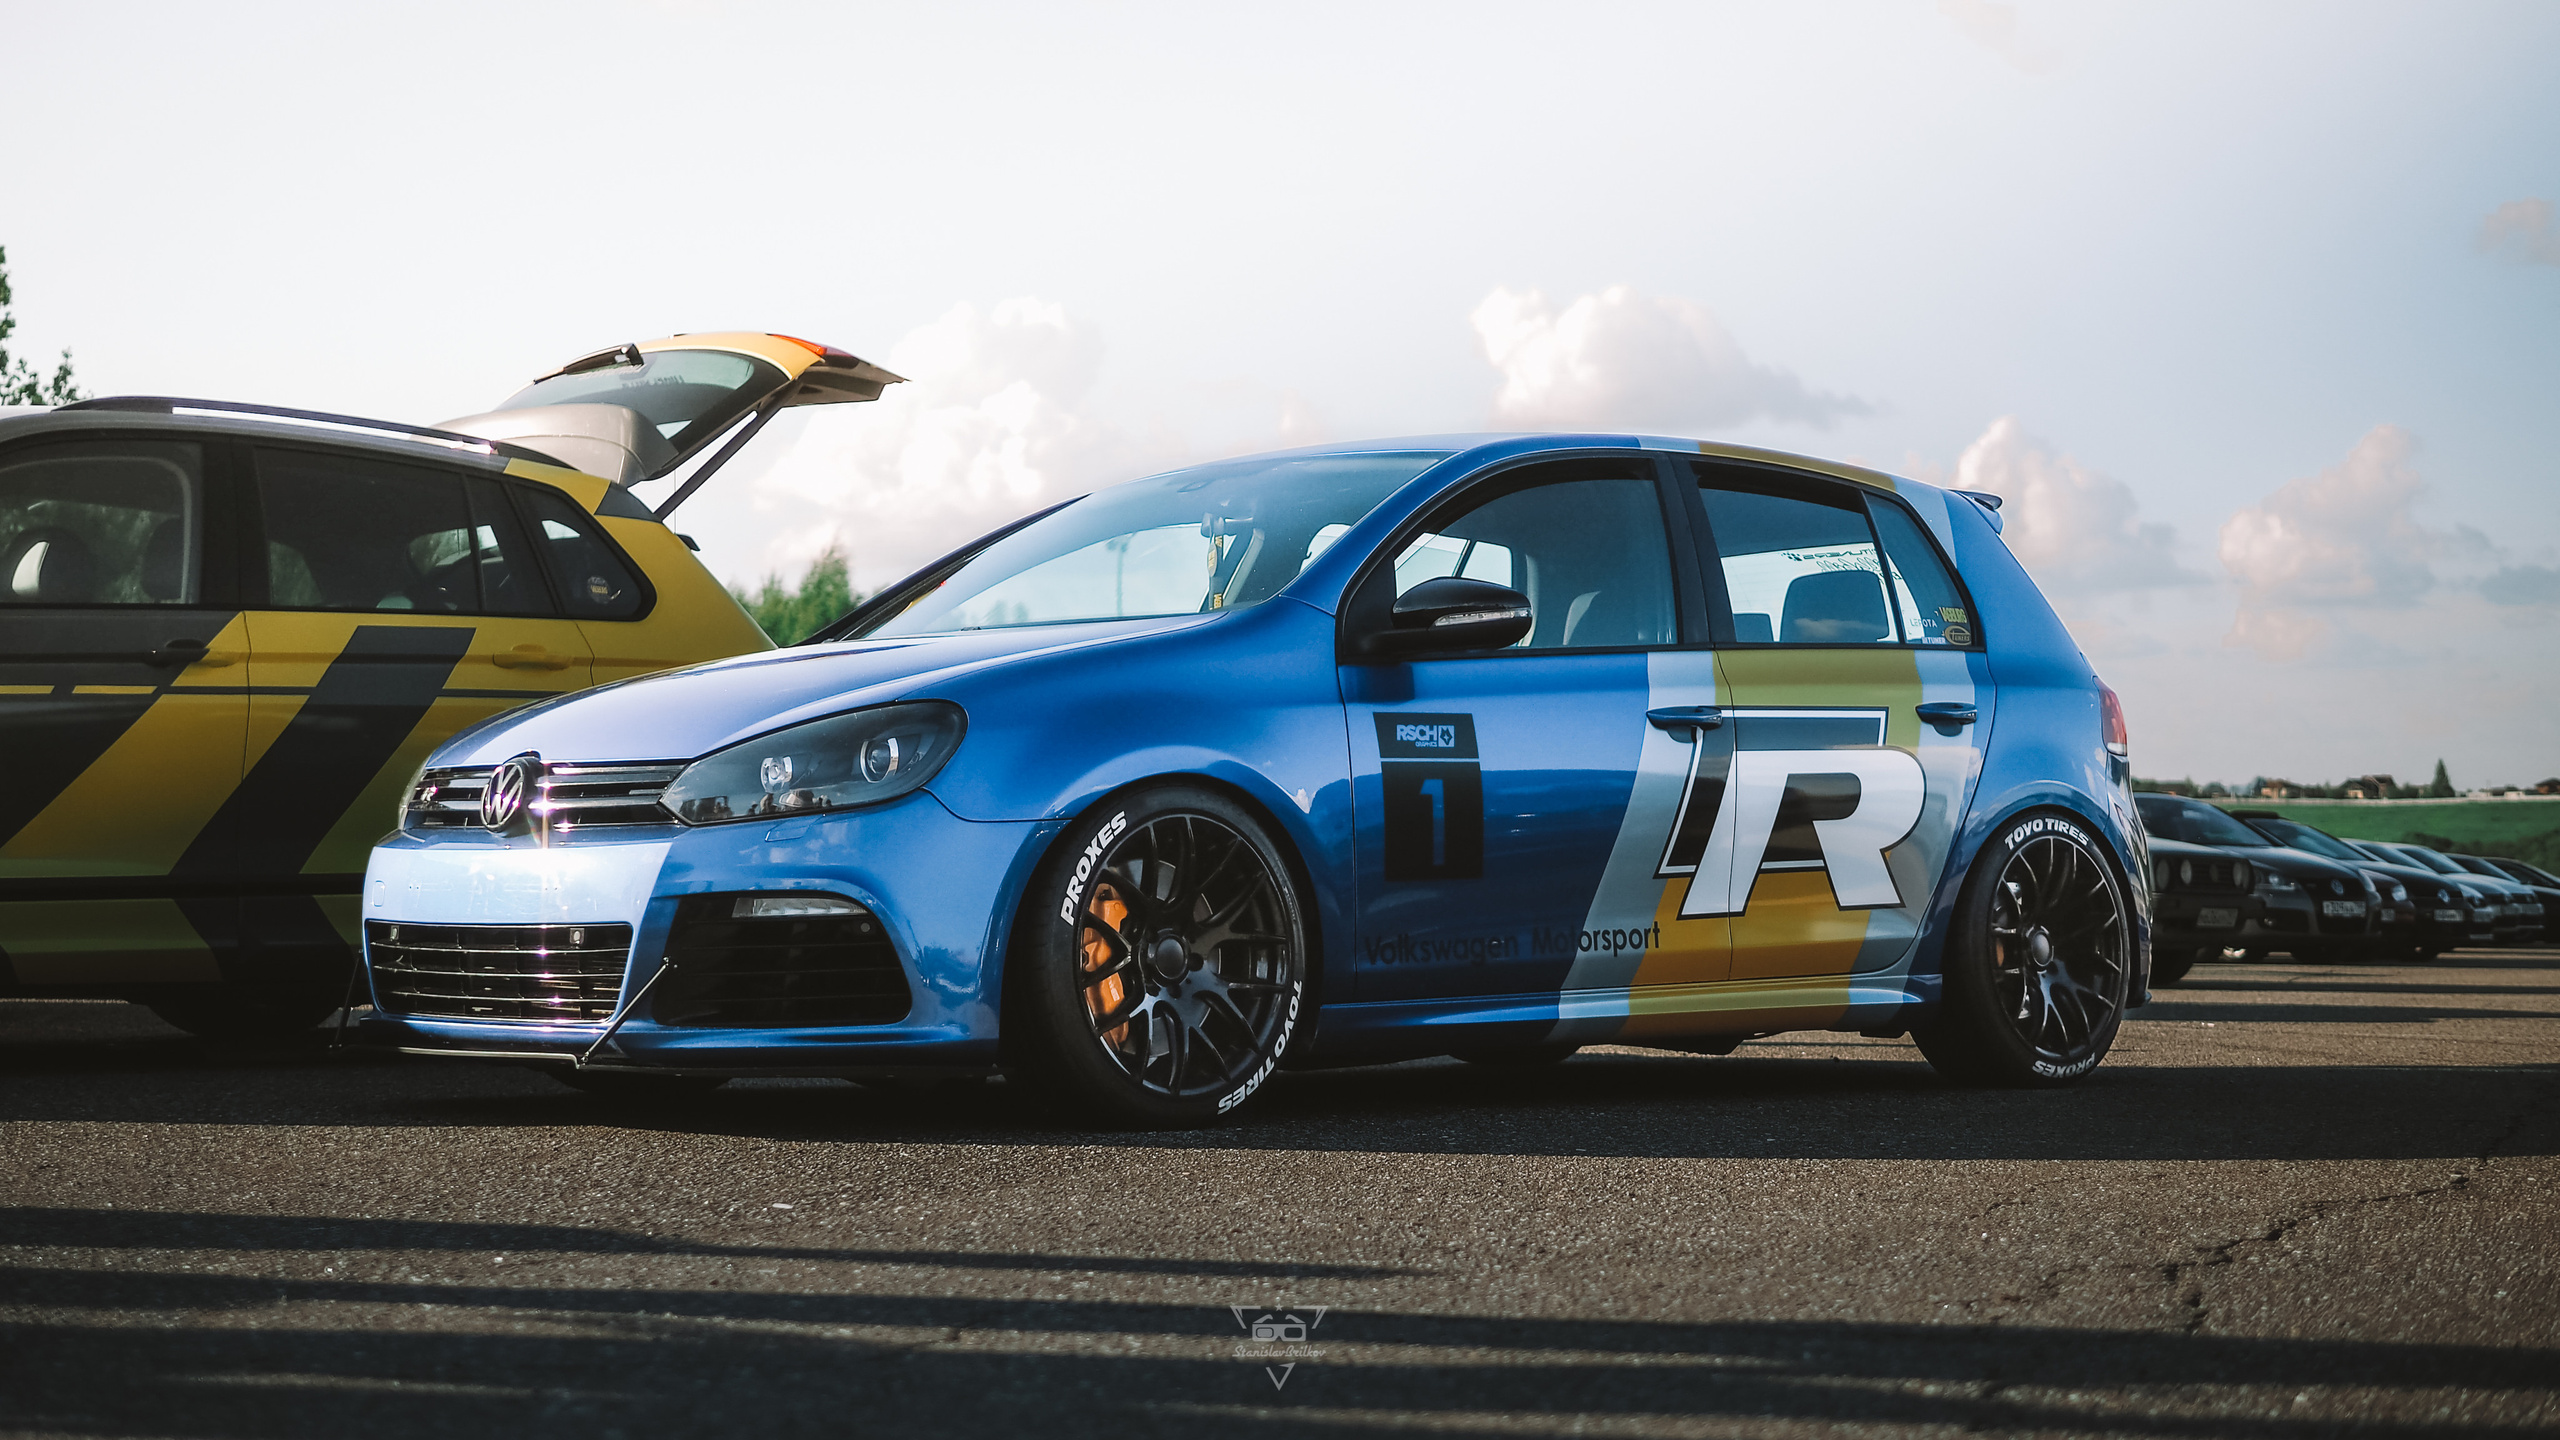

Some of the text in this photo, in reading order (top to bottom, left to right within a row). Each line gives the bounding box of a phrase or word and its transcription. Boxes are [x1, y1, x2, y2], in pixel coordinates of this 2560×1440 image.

[1396, 724, 1438, 741] RSCH
[1420, 778, 1445, 866] 1
[2004, 817, 2089, 850] TOYO TIRES
[1060, 811, 1127, 926] PROXES
[1364, 920, 1661, 967] Volkswagen Motorsport
[1216, 979, 1303, 1116] TOYO TIRES
[2032, 1052, 2096, 1079] PROXES
